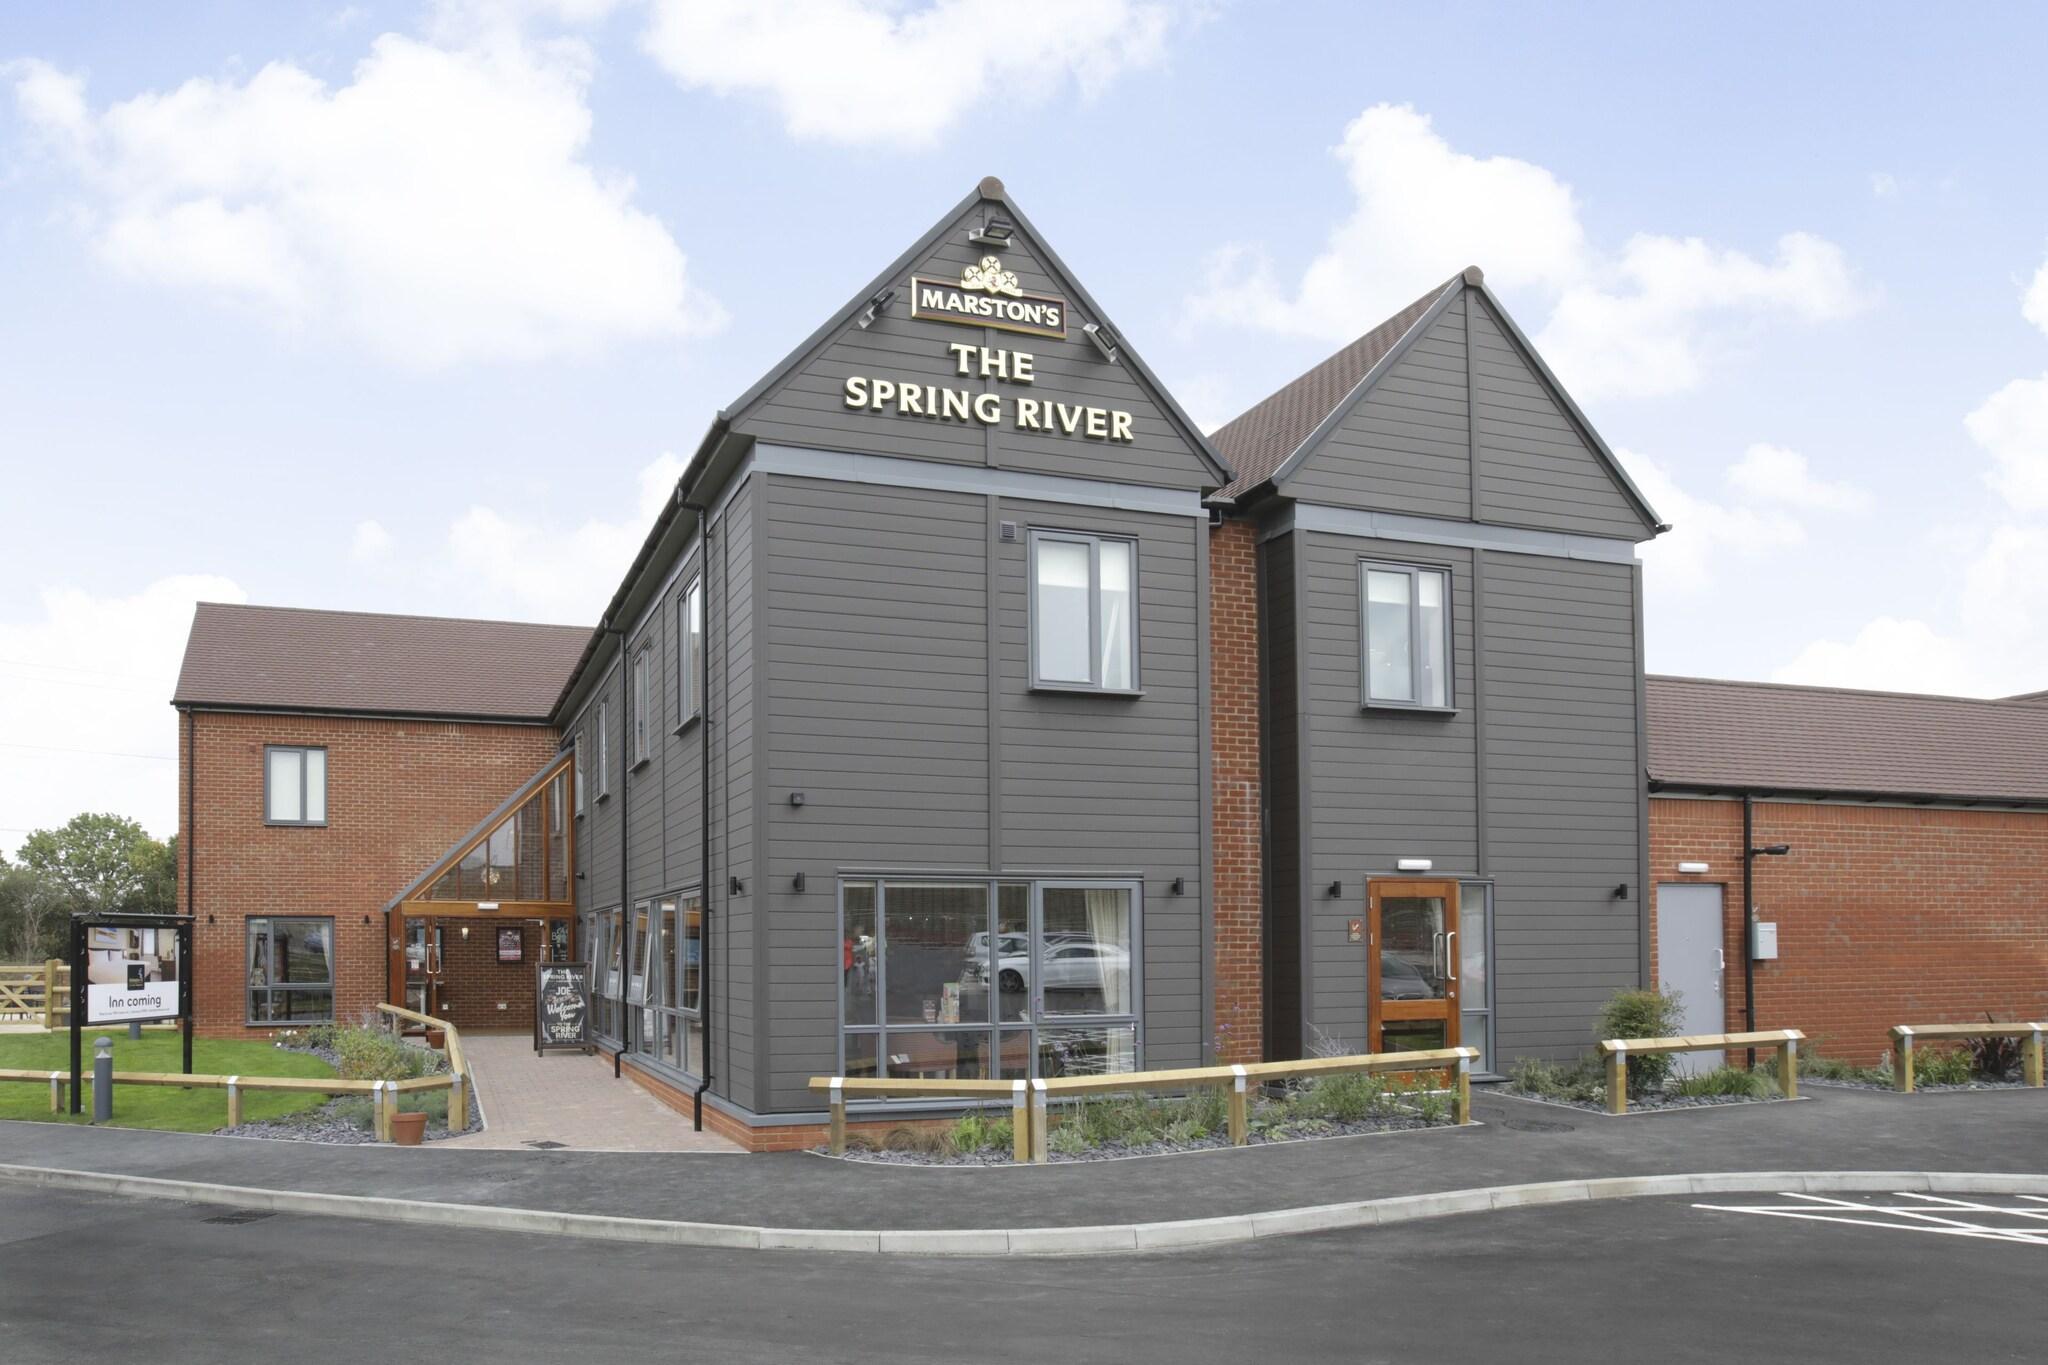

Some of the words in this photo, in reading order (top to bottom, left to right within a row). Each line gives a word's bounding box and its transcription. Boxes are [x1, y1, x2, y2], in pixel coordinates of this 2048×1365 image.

[921, 288, 1060, 328] MARSTON'S
[949, 342, 1035, 384] THE
[844, 376, 1001, 425] SPRING
[1015, 397, 1134, 442] RIVER
[109, 995, 124, 1008] Inn
[127, 994, 161, 1007] coming
[550, 1025, 581, 1033] SPRING
